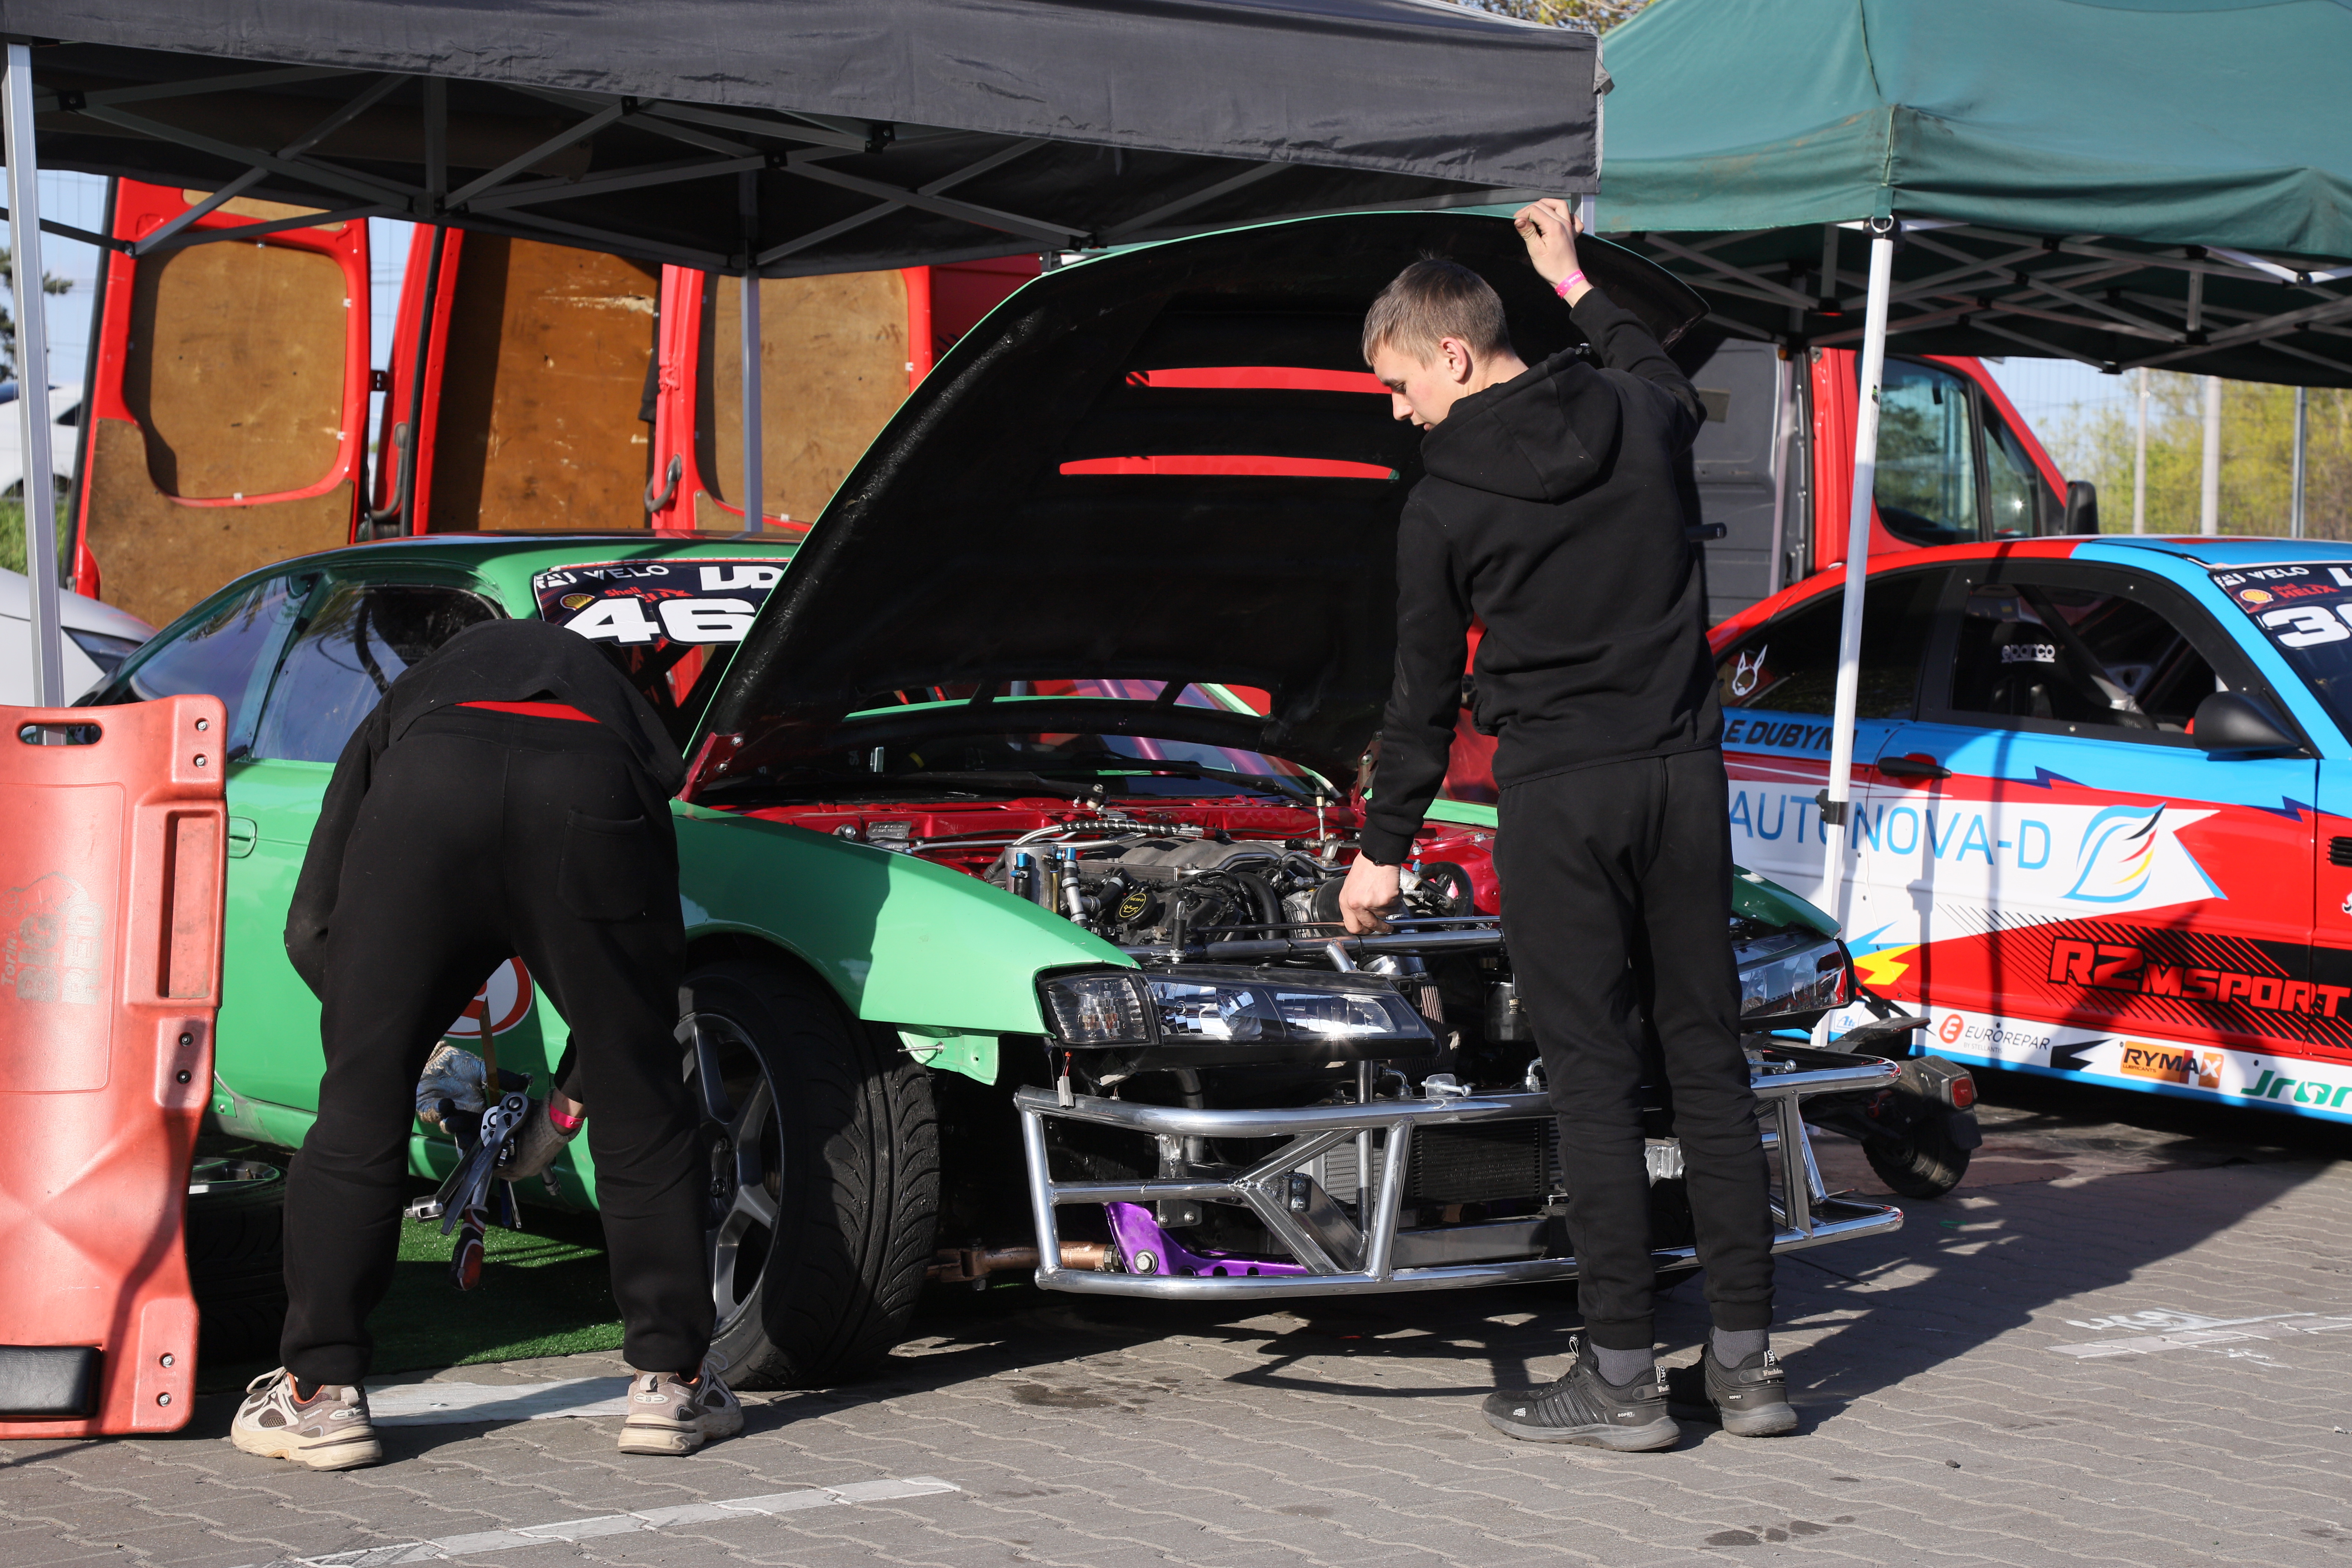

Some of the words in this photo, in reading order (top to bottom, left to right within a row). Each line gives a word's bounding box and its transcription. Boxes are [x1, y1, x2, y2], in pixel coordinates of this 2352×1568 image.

[583, 565, 669, 580] VELO
[2246, 567, 2310, 580] VELO
[604, 586, 642, 597] Shell
[2270, 583, 2298, 592] Shell
[2278, 584, 2340, 599] HELIX
[563, 597, 765, 643] 46
[2262, 603, 2352, 648] 3
[1, 937, 17, 986] Torin
[16, 913, 62, 1003] BIG
[1965, 1026, 2051, 1050] EUROREPAR
[1971, 1043, 2003, 1054] STELLANTIS
[2122, 1064, 2157, 1073] LUBRICANTS
[2123, 1048, 2222, 1079] RYMAX
